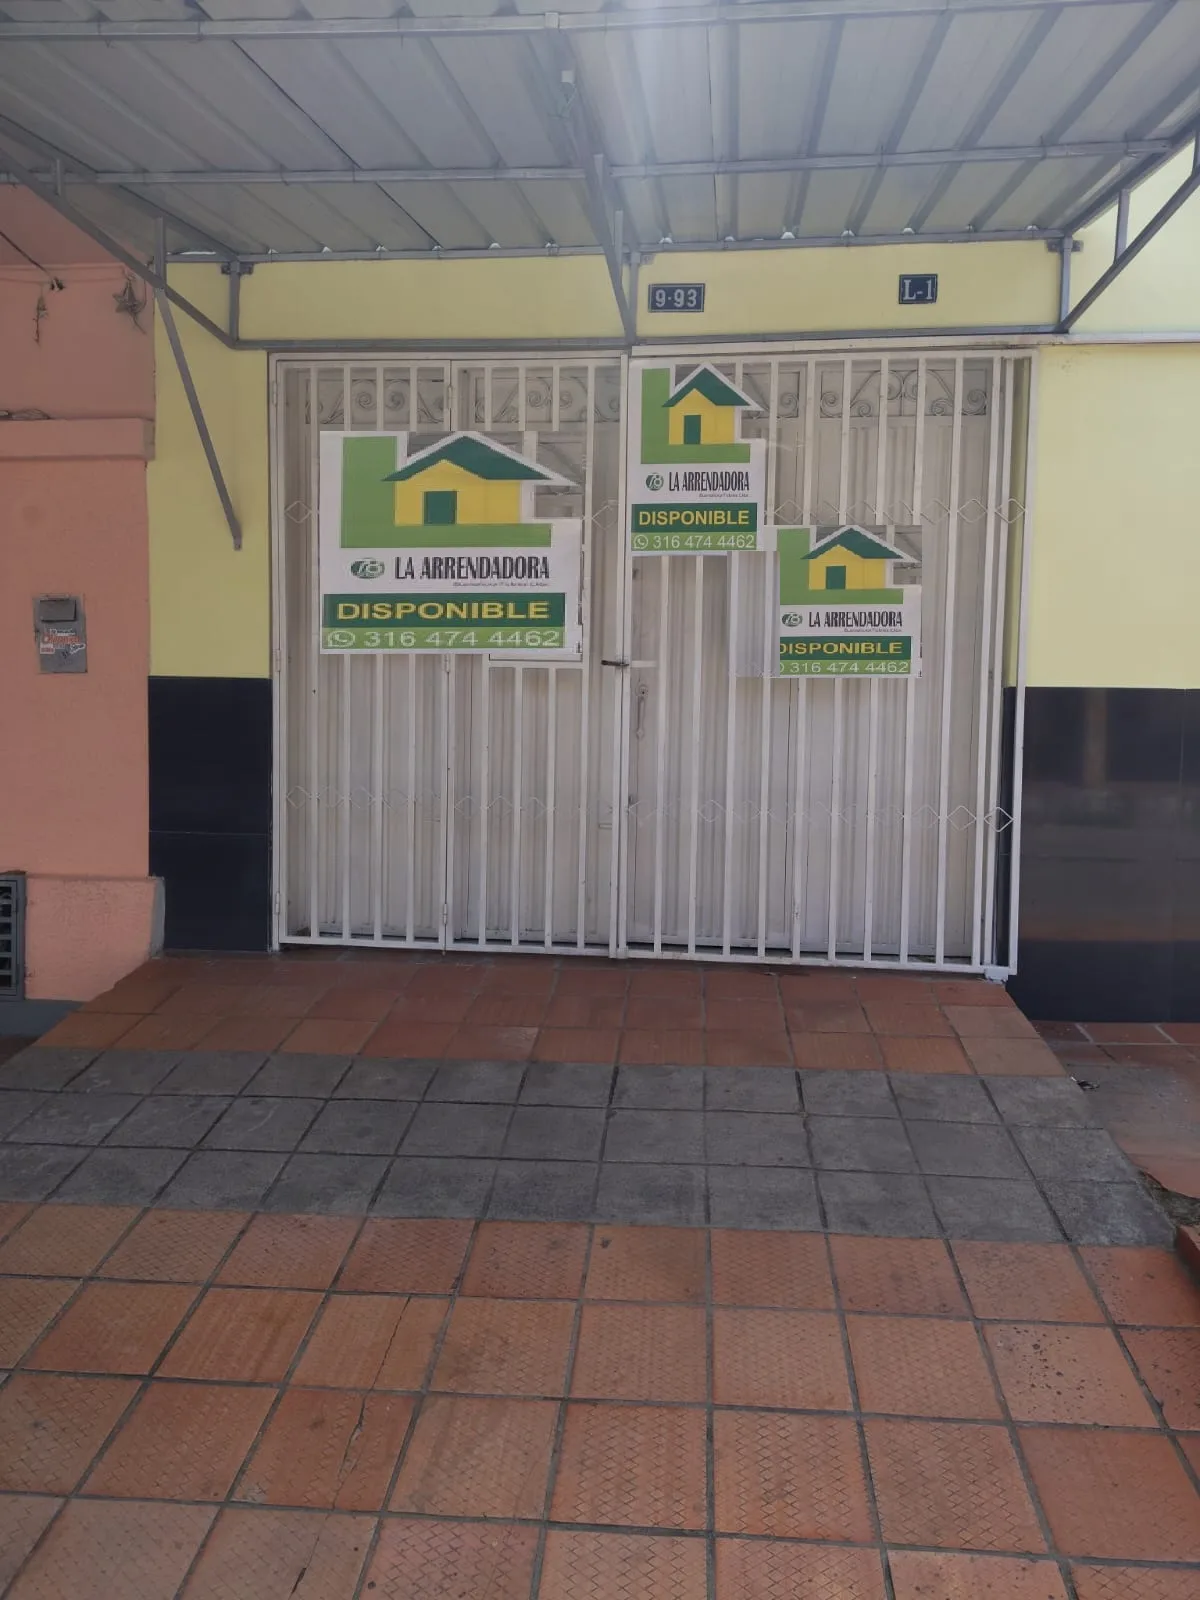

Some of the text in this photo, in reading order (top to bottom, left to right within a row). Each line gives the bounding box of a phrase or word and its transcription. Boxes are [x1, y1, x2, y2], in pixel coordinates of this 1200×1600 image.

[903, 279, 933, 300] L-1
[669, 472, 679, 491] LA
[682, 471, 749, 491] ARRENDADORA
[639, 510, 749, 525] DISPONIBLE
[653, 535, 755, 548] 316 474 4462
[395, 557, 415, 579] LA
[419, 556, 550, 579] ARRENDADORA
[337, 601, 550, 620] DISPONIBLE
[809, 612, 821, 627] LA
[824, 611, 902, 627] ARRENDADORA
[364, 630, 560, 647] 316 474 4462
[790, 661, 909, 673] 316 474 4462
